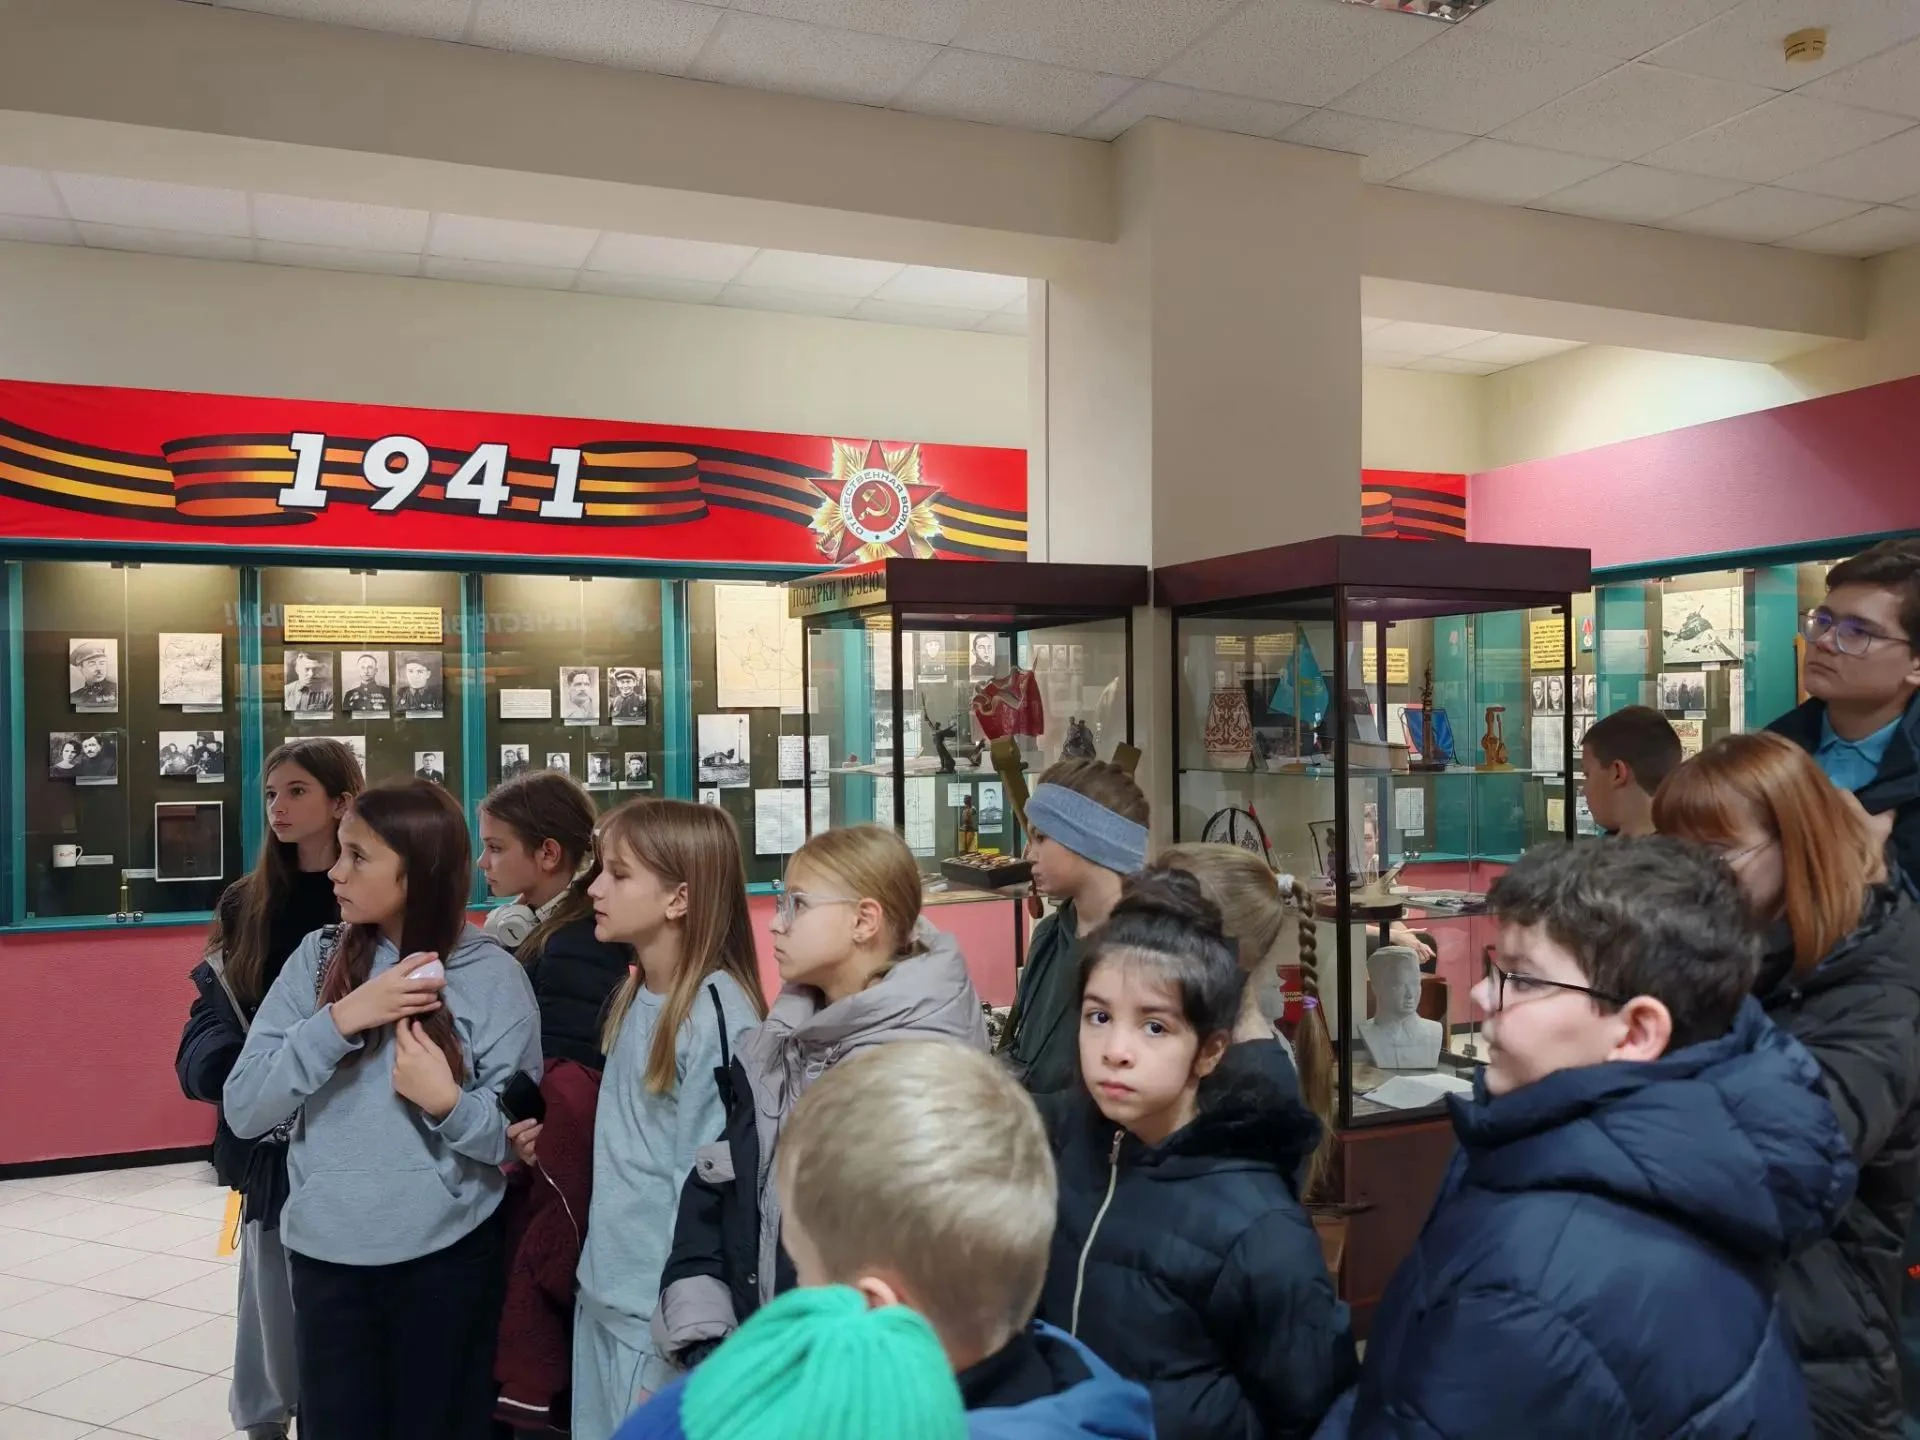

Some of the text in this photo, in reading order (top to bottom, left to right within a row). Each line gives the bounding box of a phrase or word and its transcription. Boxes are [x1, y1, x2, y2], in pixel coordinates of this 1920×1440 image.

[278, 432, 584, 518] 1941
[793, 571, 880, 608] ПОДАРКИ МУЗЕЮ
